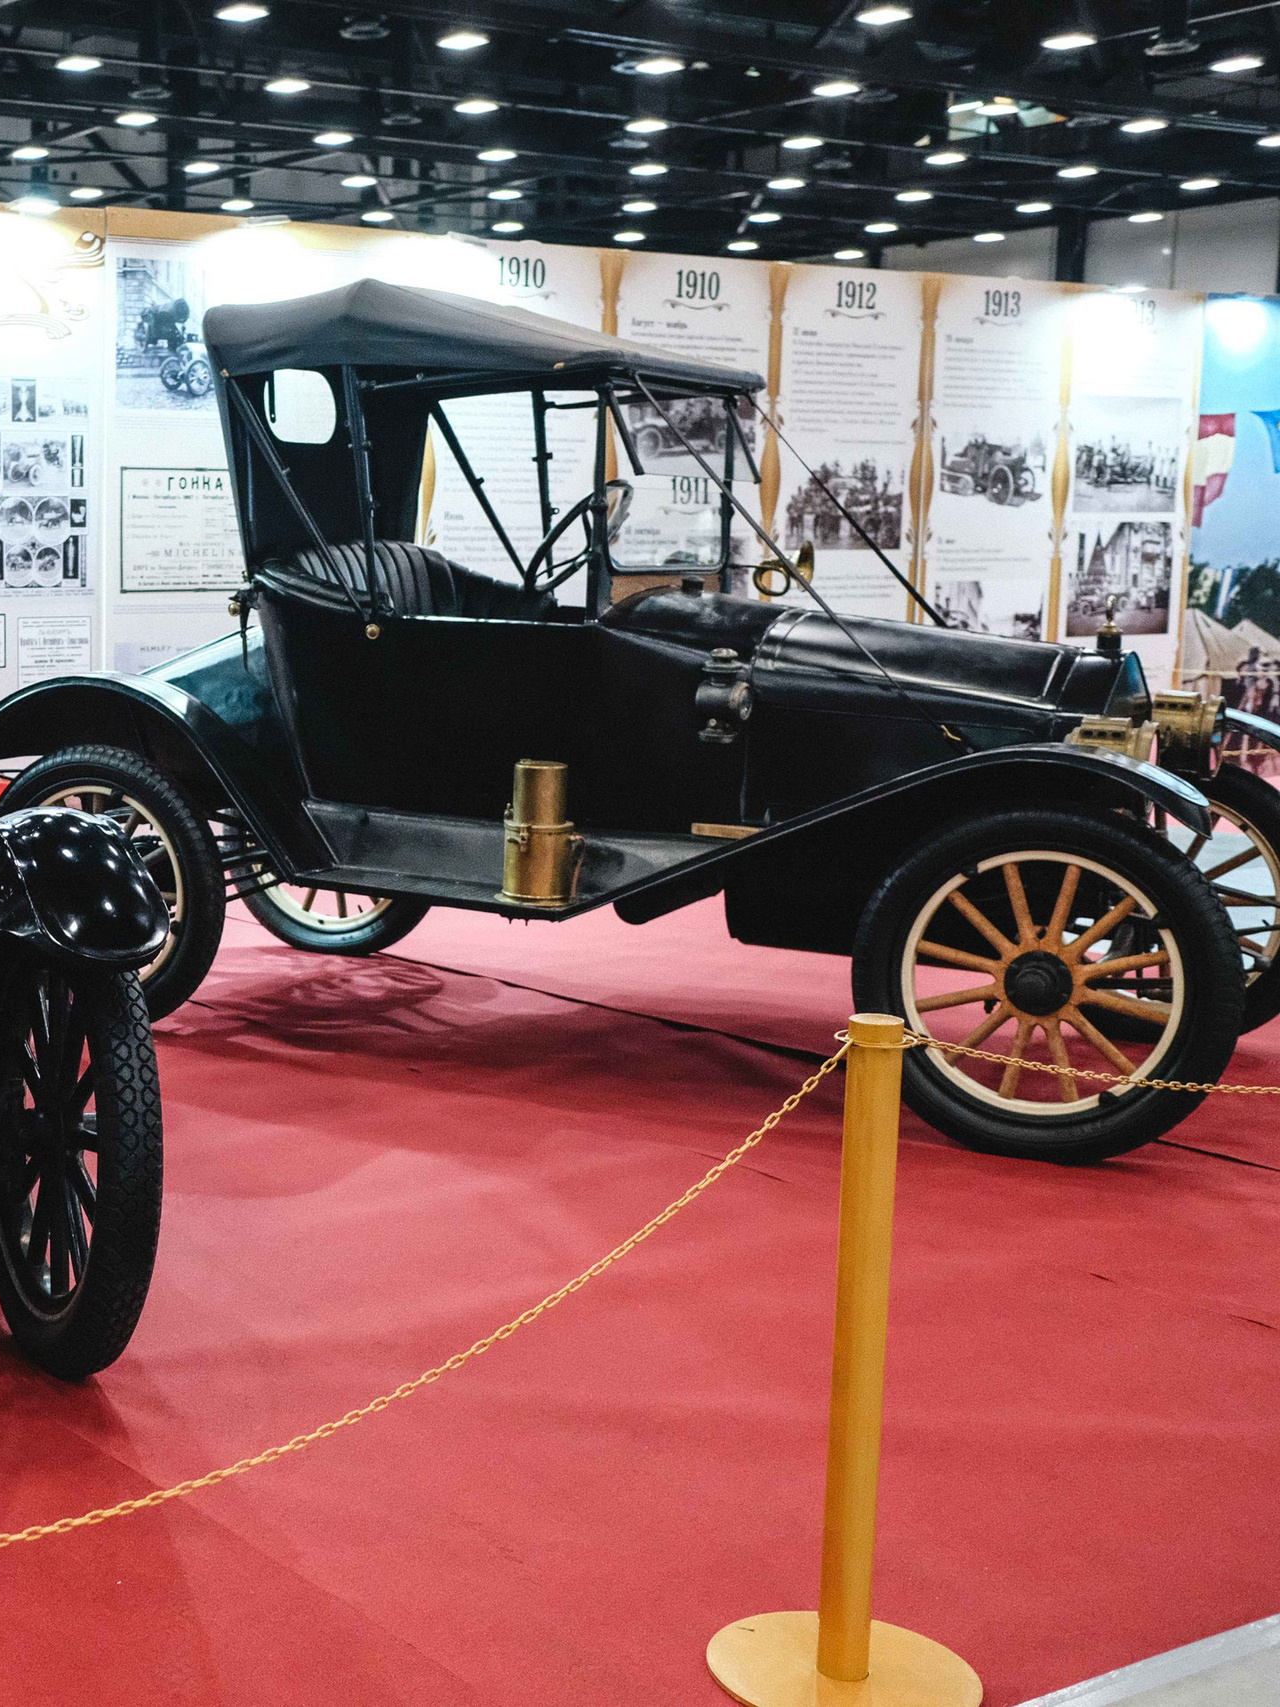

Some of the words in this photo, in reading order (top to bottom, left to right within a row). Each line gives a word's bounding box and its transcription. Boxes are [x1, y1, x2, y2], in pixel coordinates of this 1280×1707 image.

[499, 256, 546, 288] 1910
[675, 269, 721, 300] 1910
[836, 280, 877, 309] 1912
[984, 289, 1021, 317] 1913
[671, 475, 711, 505] 1911
[164, 548, 235, 557] MICHELIN
